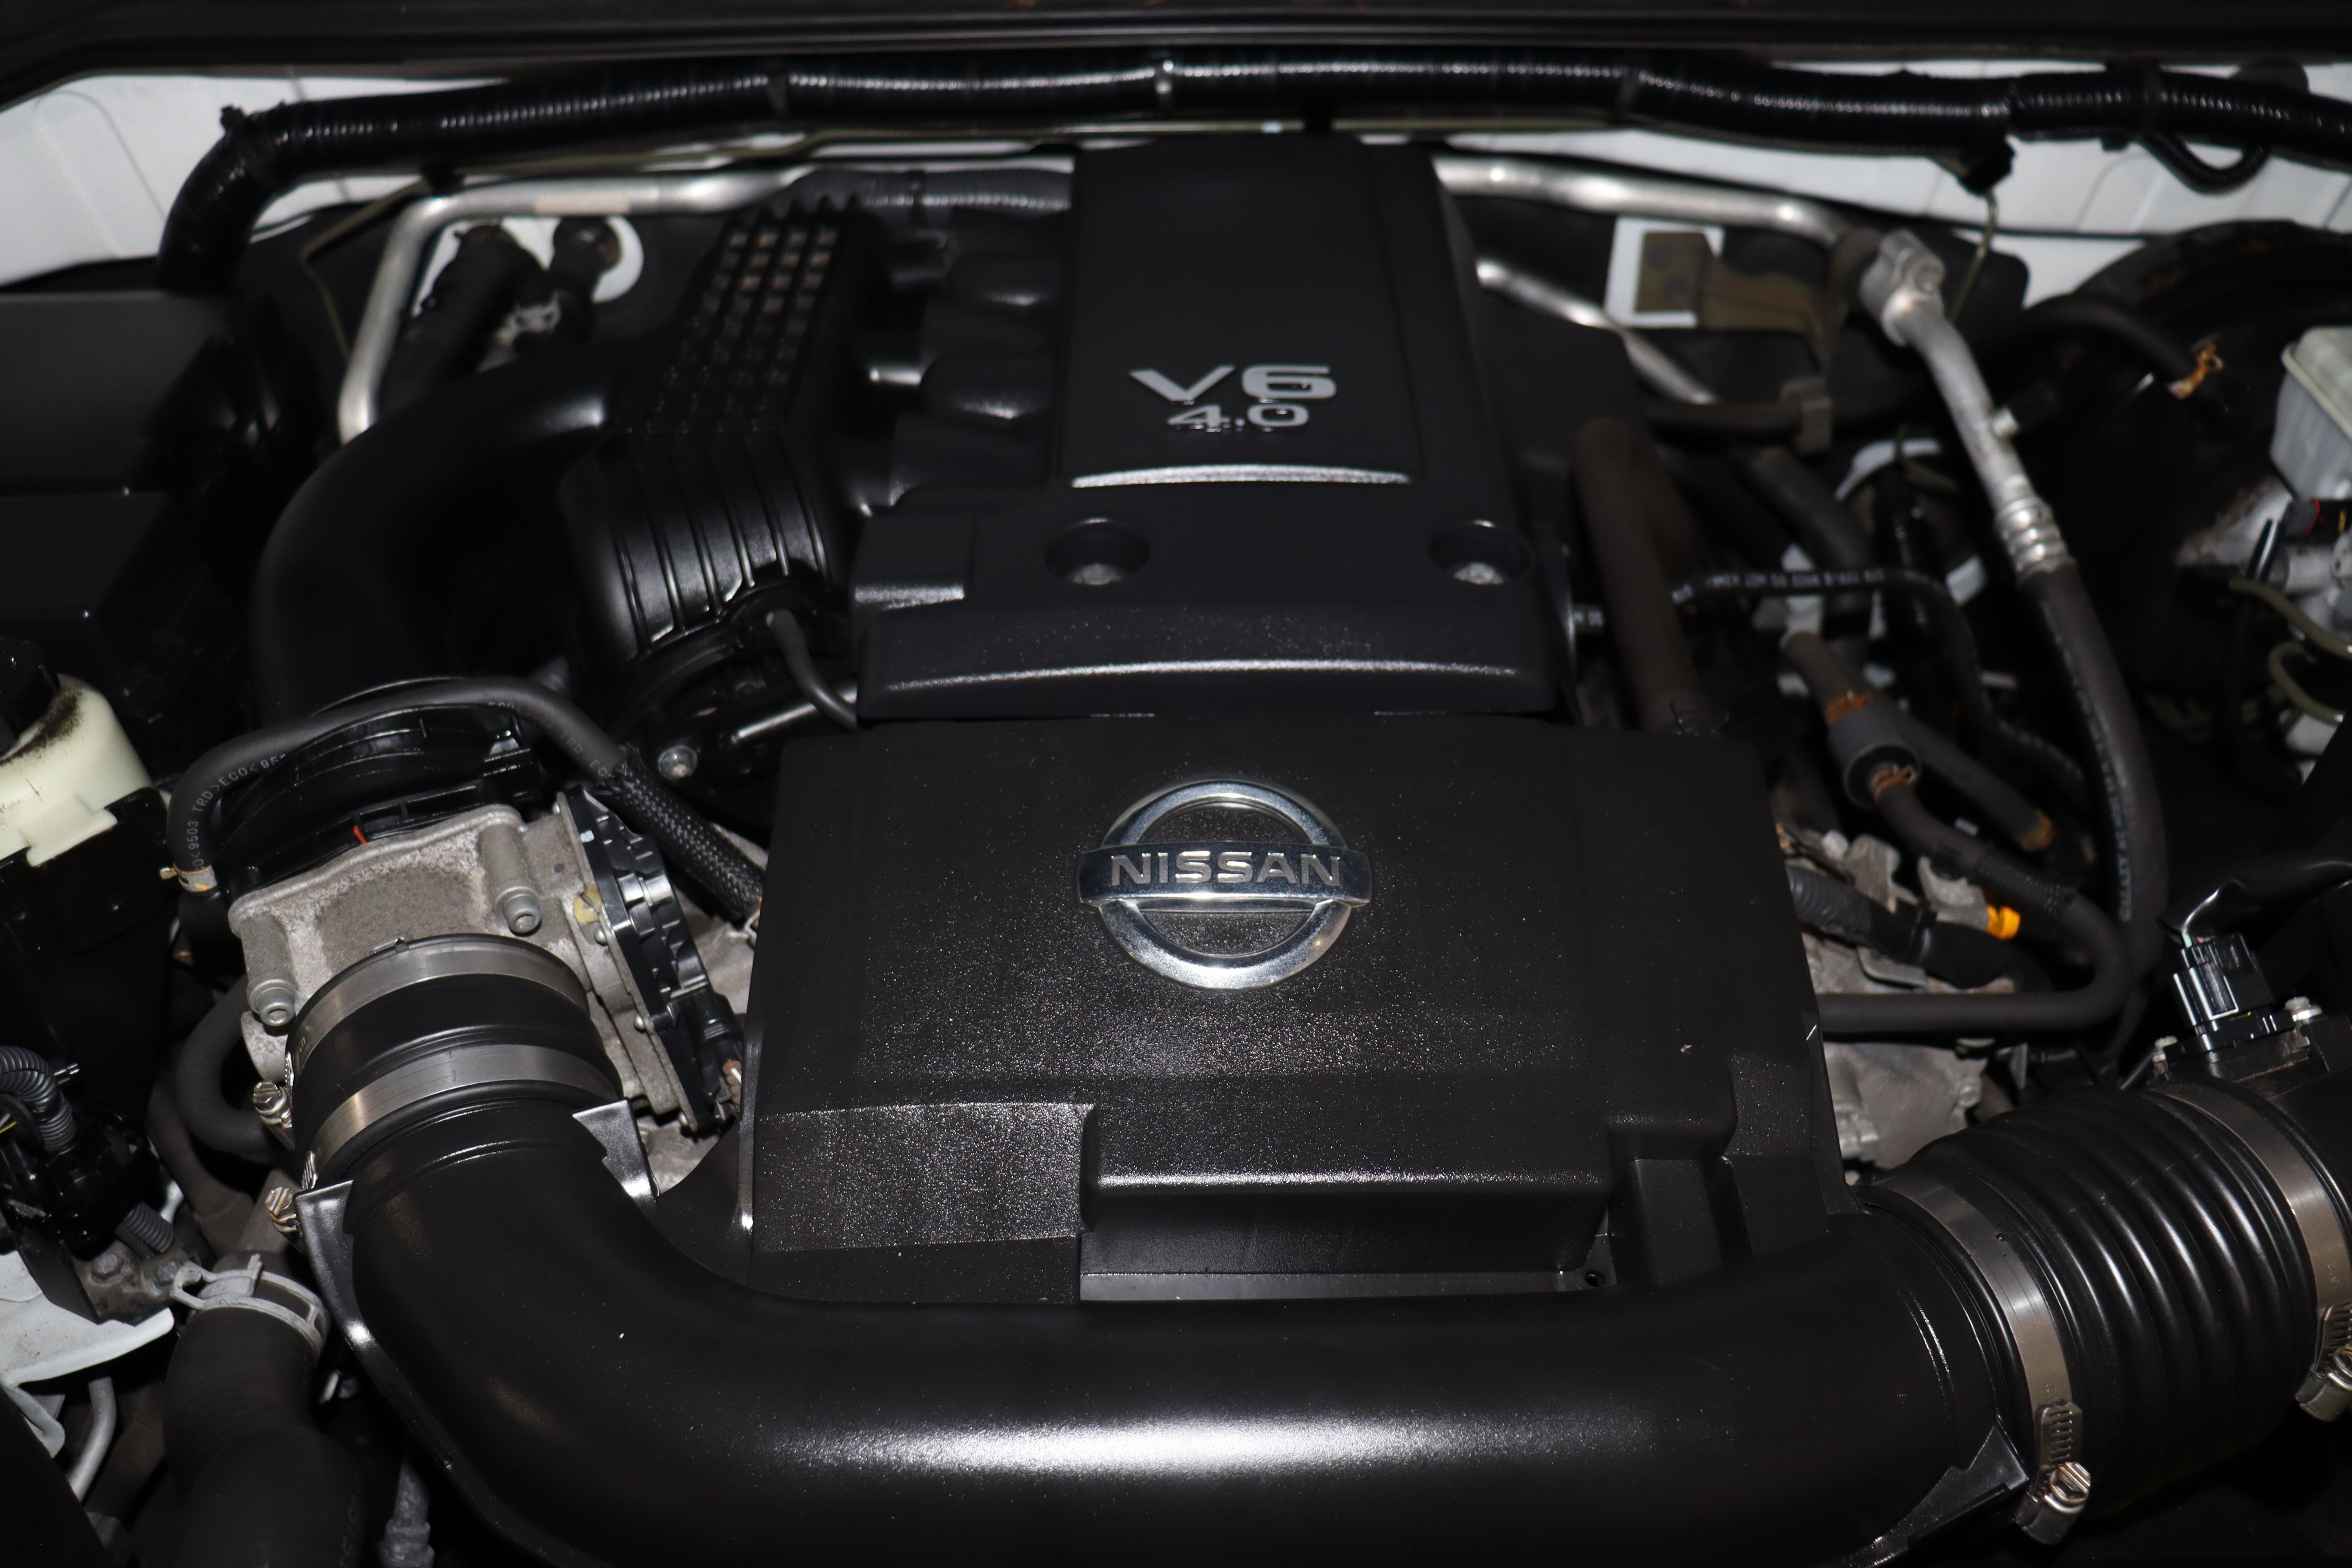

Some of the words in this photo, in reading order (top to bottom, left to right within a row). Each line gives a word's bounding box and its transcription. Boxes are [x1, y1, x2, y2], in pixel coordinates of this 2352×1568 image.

[1128, 364, 1337, 401] V6
[1167, 403, 1310, 430] 4.0
[1110, 851, 1341, 886] NISSAN
